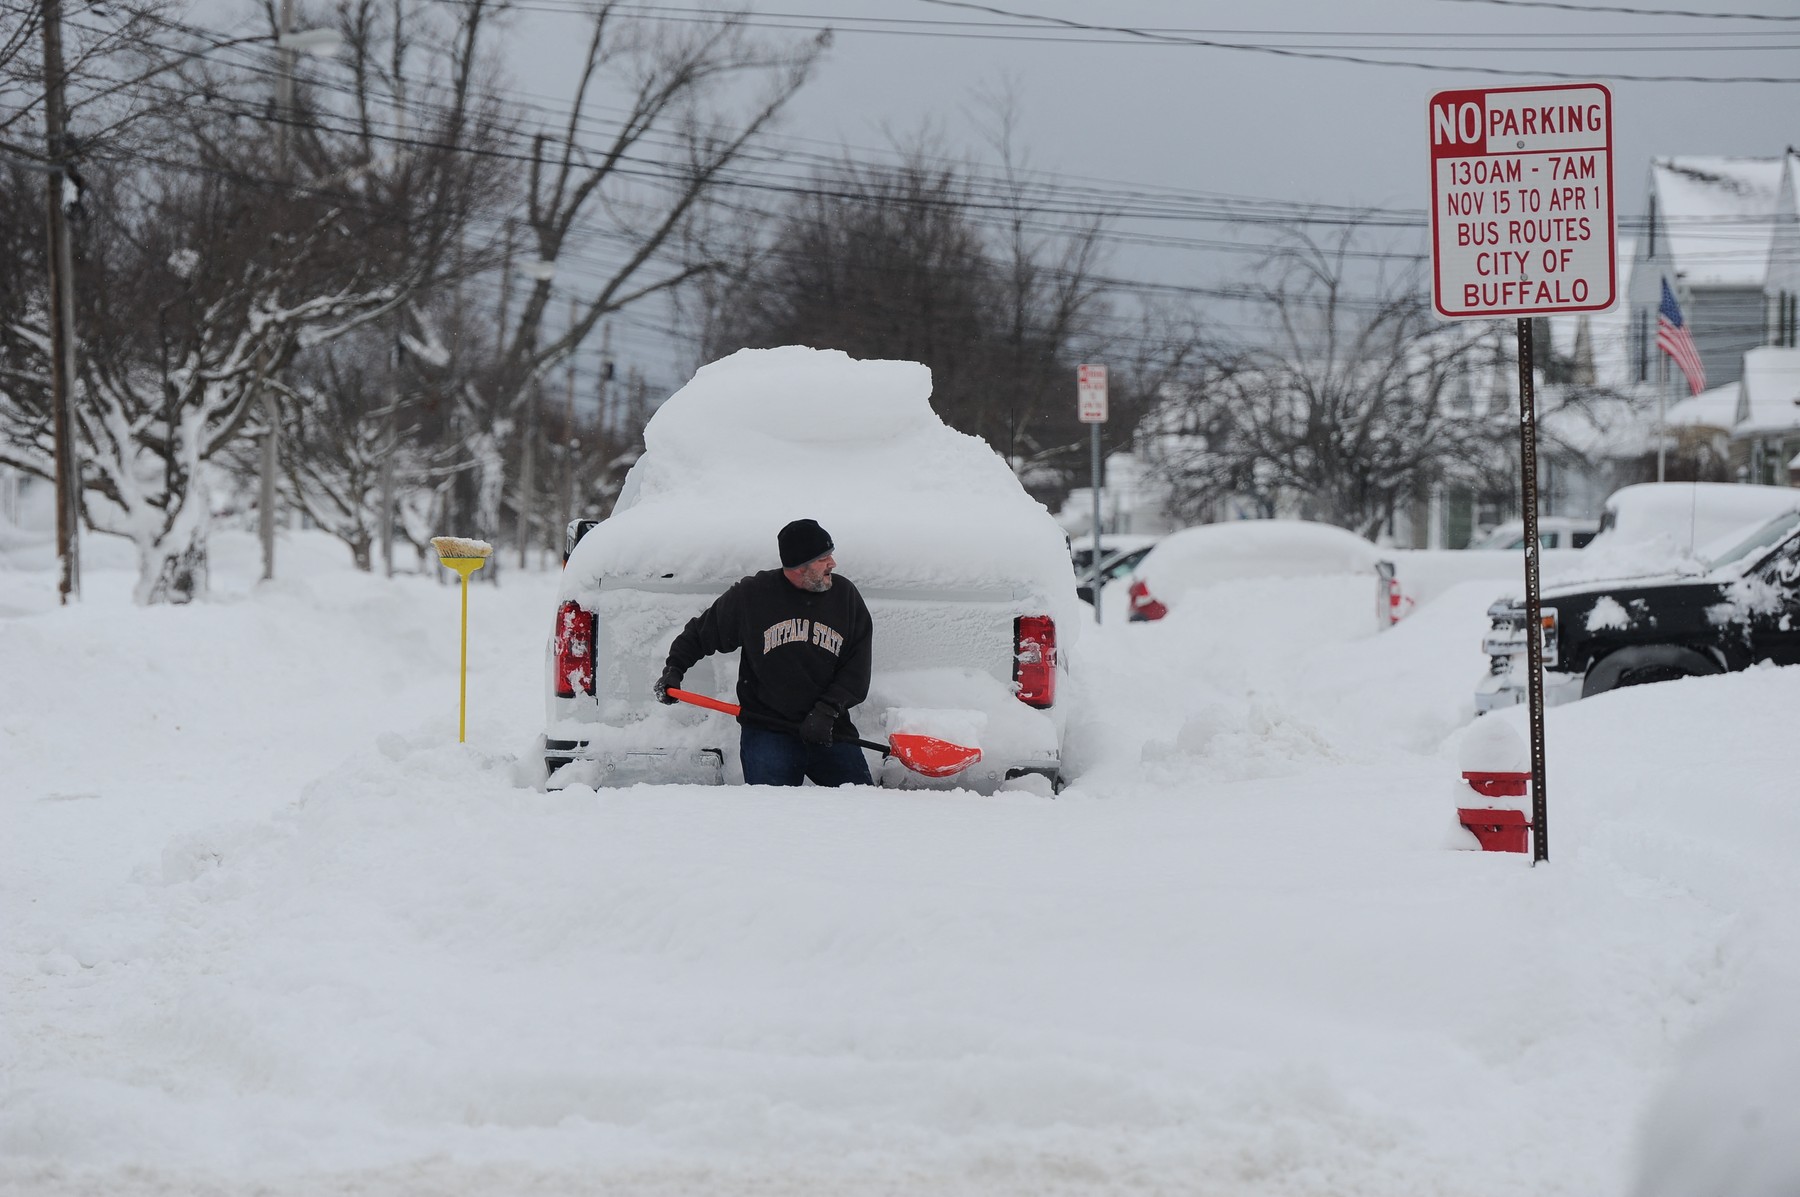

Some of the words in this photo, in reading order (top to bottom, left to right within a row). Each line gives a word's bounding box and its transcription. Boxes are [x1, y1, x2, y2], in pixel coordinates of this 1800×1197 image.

[1433, 101, 1482, 145] NO
[1489, 104, 1601, 137] PARKING
[1450, 159, 1522, 186] 130AM
[1548, 155, 1595, 181] 7AM
[1448, 191, 1484, 216] NOV
[1492, 190, 1511, 214] 15
[1518, 188, 1541, 213] TO
[1549, 187, 1586, 212] APR
[1594, 186, 1600, 210] 1
[1457, 221, 1500, 246] BUS
[1509, 217, 1591, 244] ROUTES
[1476, 250, 1530, 276] CITY
[1542, 249, 1574, 273] OF
[1464, 278, 1589, 307] BUFFALO
[763, 618, 810, 655] BUFFALO
[812, 621, 844, 657] STATE
